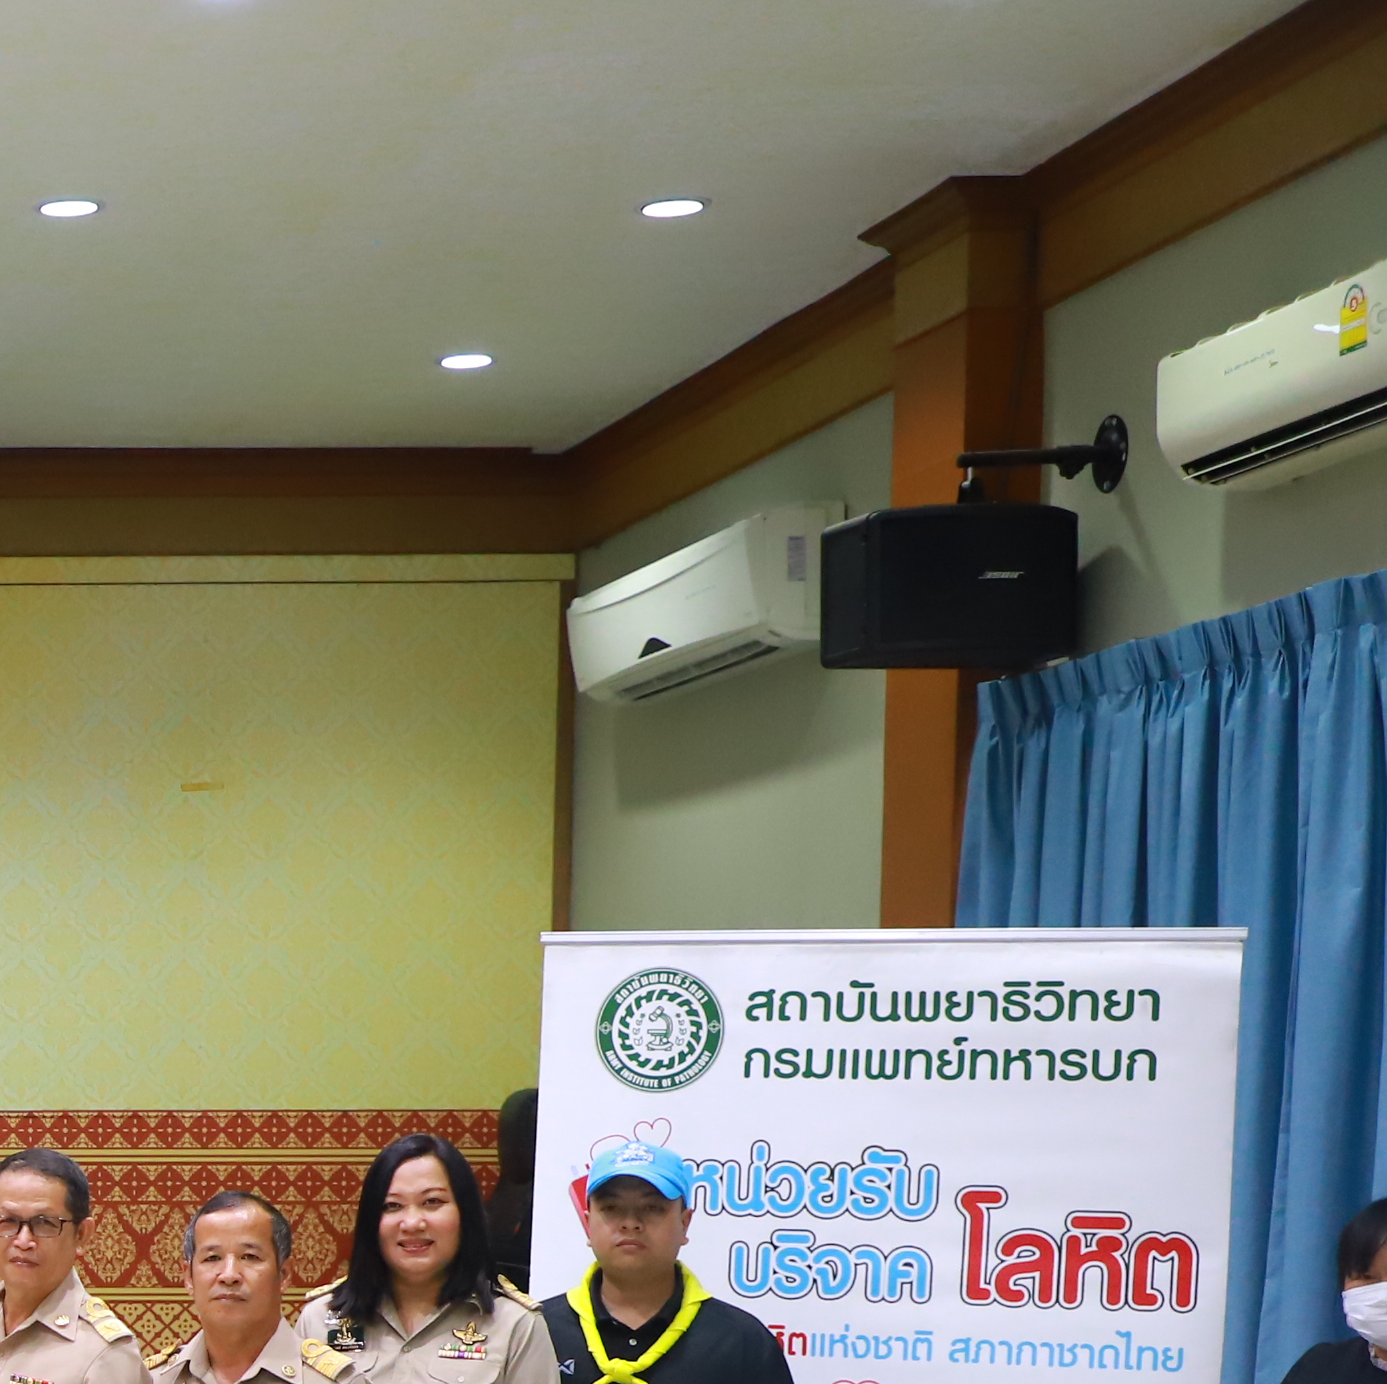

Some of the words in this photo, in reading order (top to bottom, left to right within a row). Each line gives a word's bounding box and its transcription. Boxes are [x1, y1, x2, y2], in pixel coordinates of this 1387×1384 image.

[745, 979, 1162, 1024] สถาบันพยาธิวิทยา
[743, 1036, 1157, 1083] กรมแพทย์ทหารบก
[730, 1229, 932, 1303] บริจาค
[955, 1184, 1199, 1313] โลหิต
[948, 1330, 1184, 1373] สภากาชาดไทย
